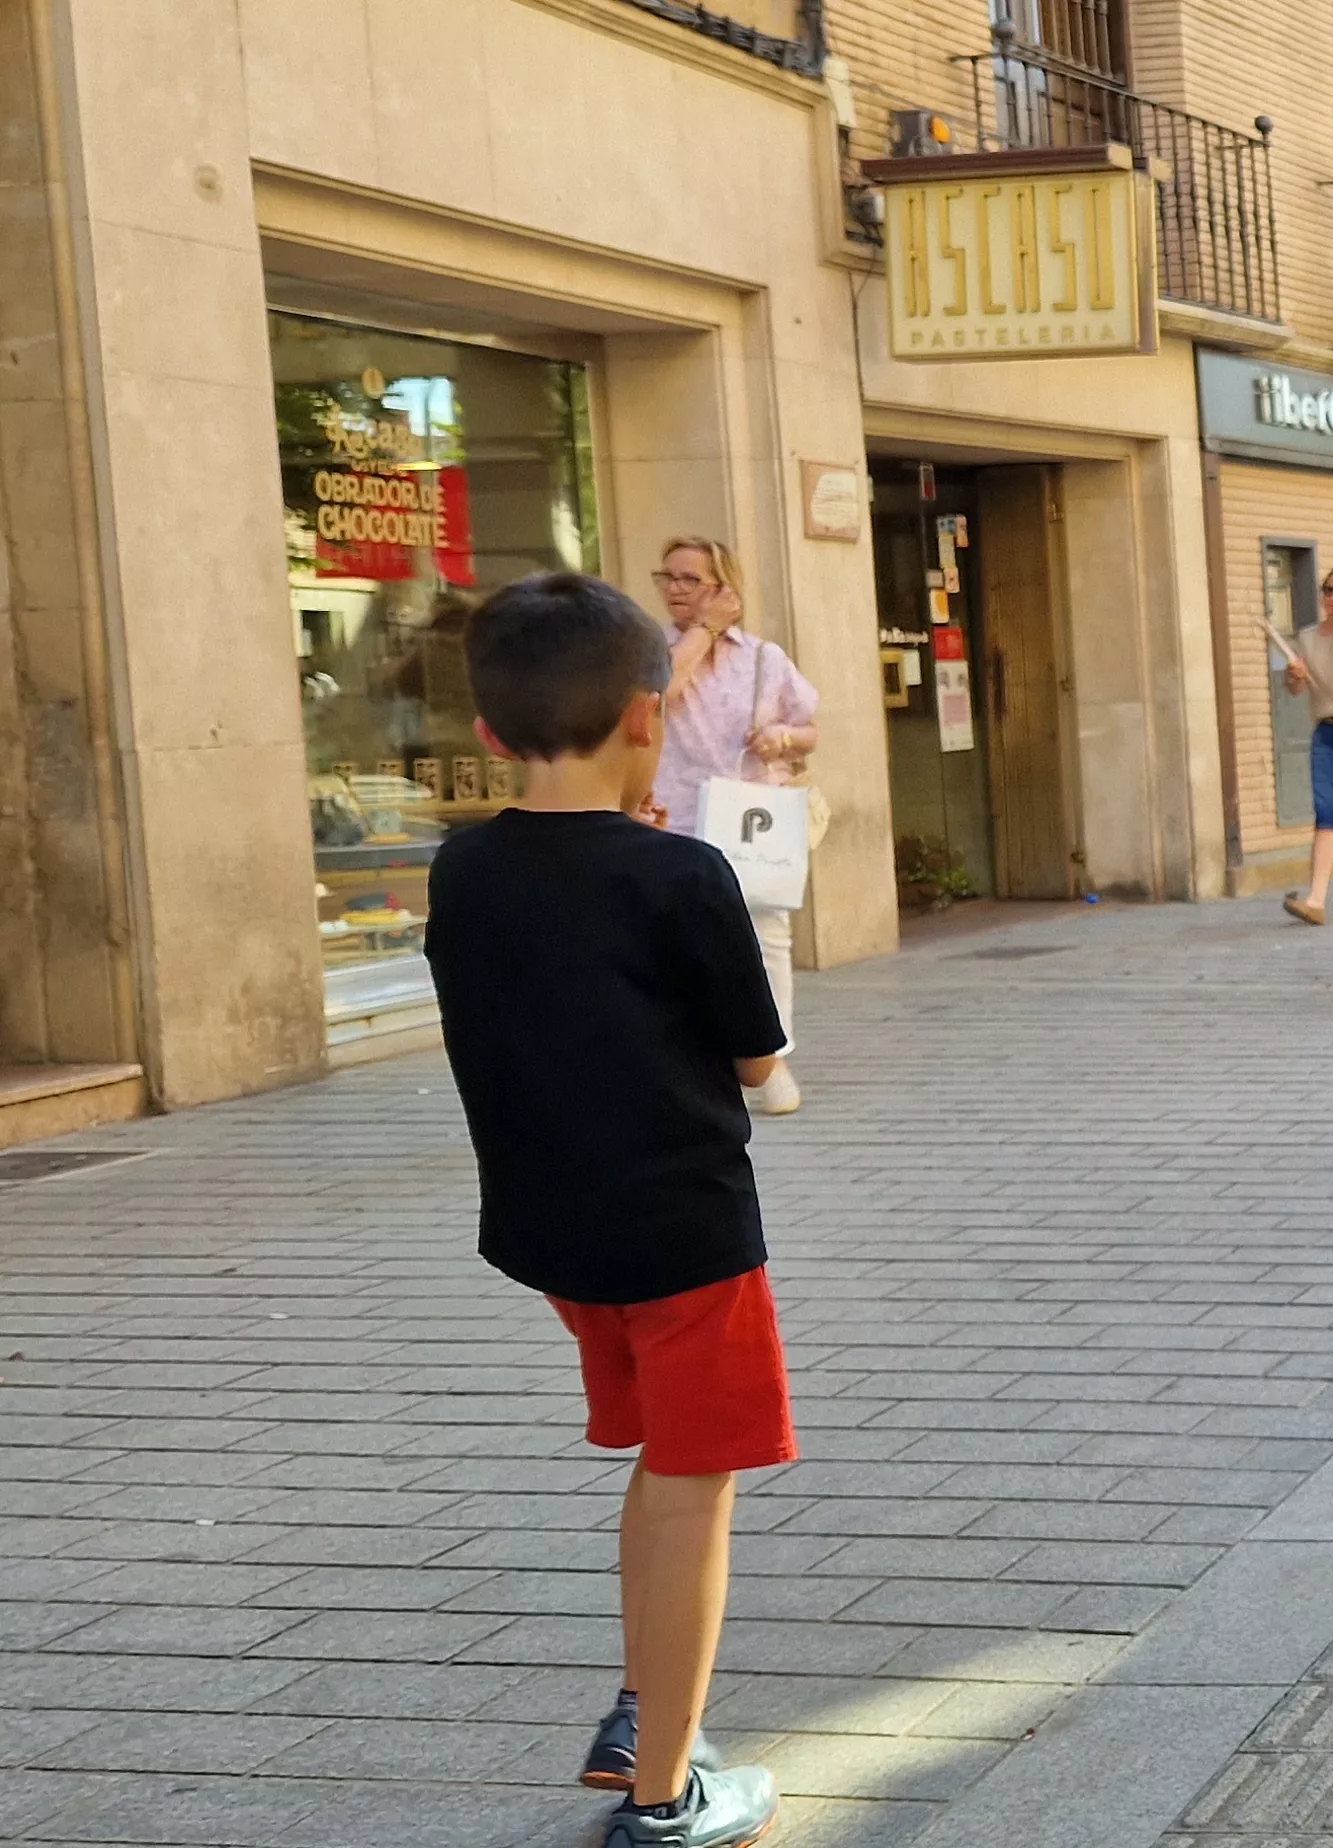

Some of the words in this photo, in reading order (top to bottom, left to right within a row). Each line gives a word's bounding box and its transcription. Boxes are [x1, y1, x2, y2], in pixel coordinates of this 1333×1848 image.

[903, 182, 1116, 318] ASCASO
[910, 323, 1116, 347] PASTELERIA
[315, 470, 420, 509] OBRADOR
[420, 484, 446, 513] DE
[317, 504, 451, 548] CHOCOLATE
[741, 807, 773, 844] P
